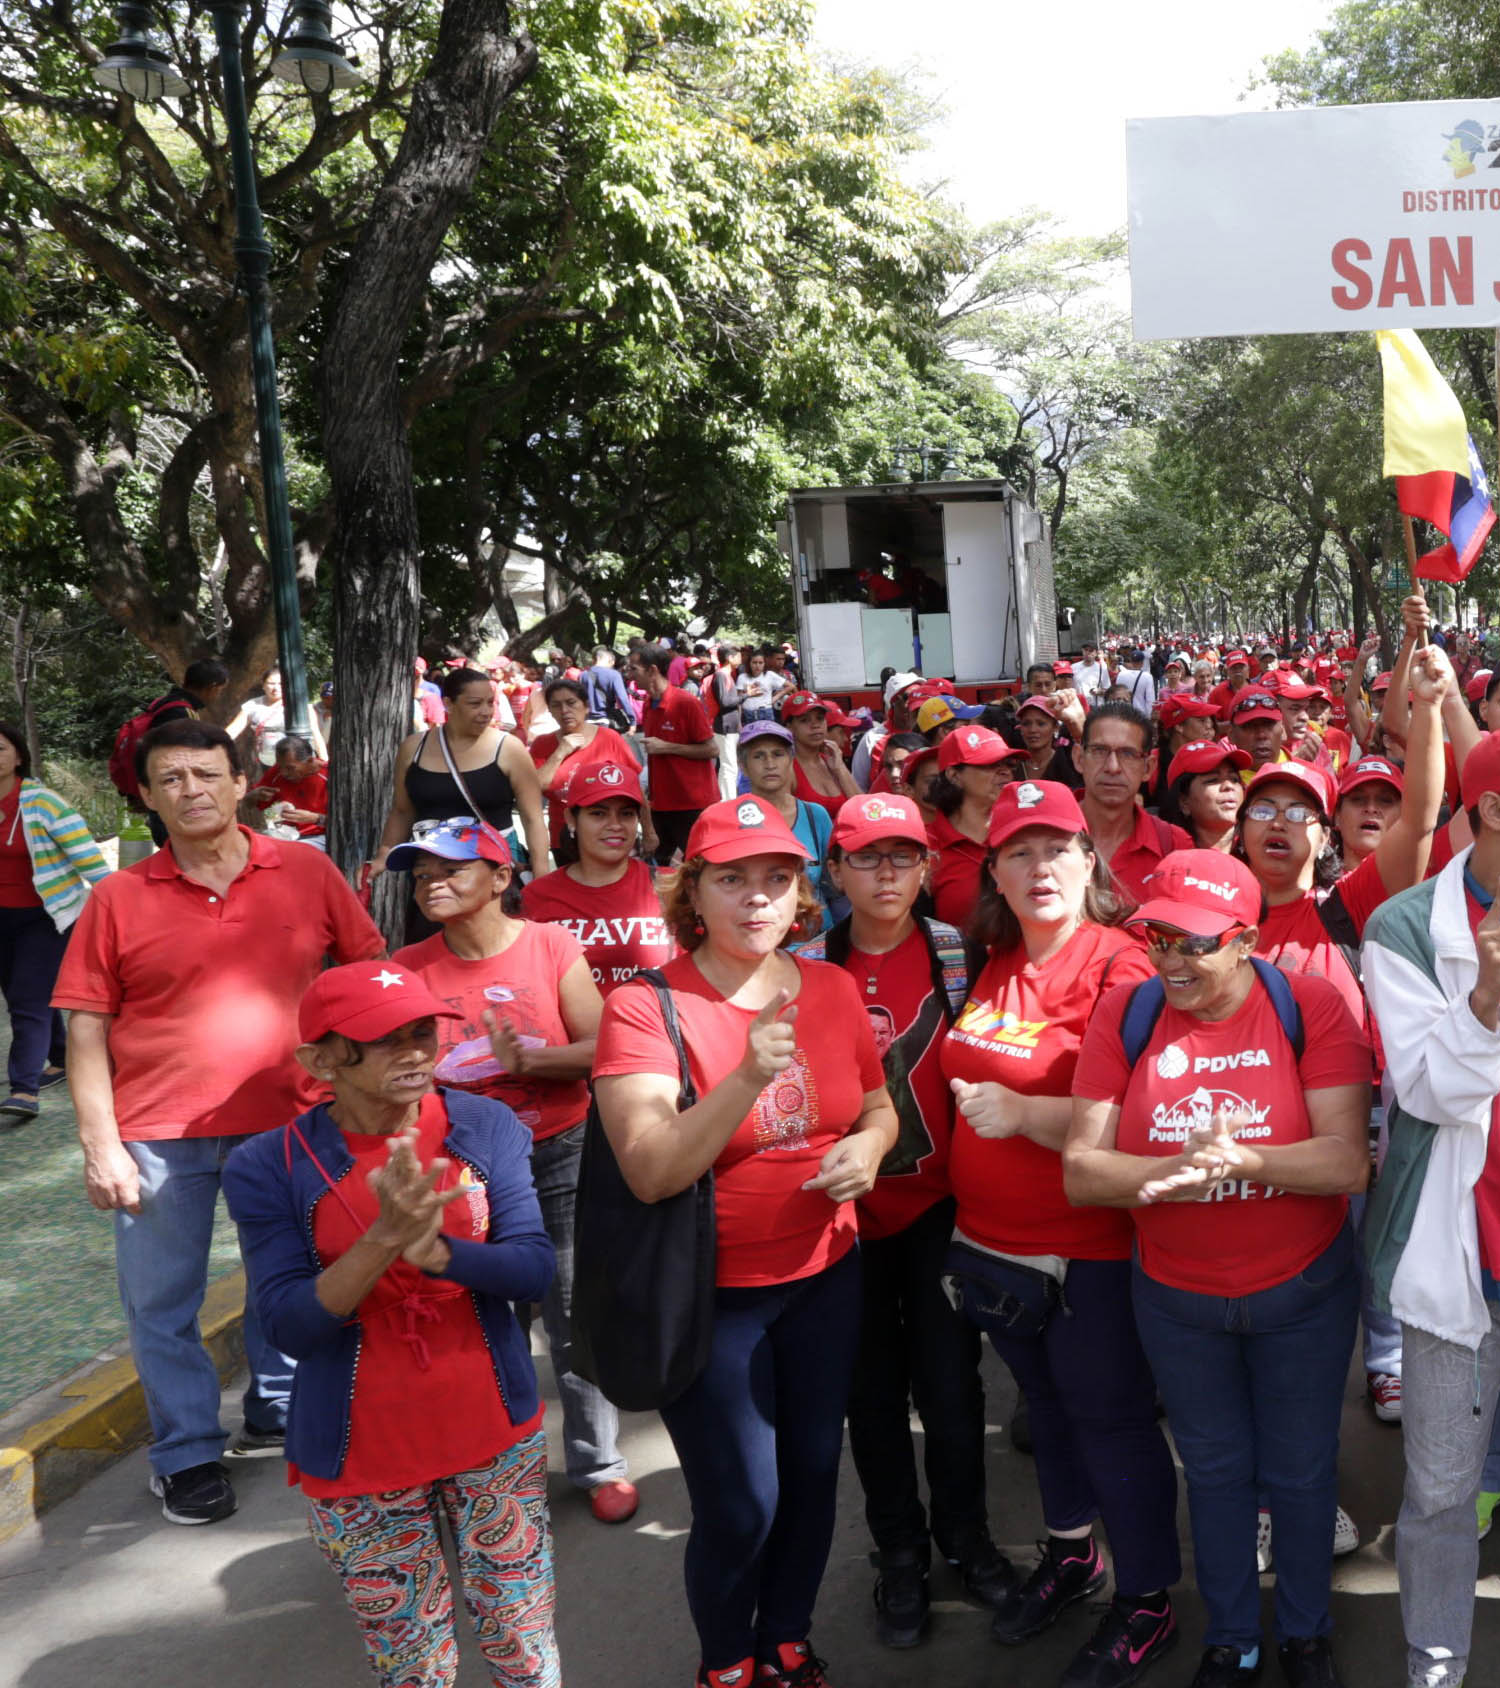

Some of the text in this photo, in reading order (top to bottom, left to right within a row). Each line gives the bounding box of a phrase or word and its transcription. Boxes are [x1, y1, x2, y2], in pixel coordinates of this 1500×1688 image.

[1331, 236, 1475, 311] SAN
[555, 917, 670, 946] HAVEZ
[987, 1041, 1033, 1060] PATRIA
[1193, 1049, 1271, 1074] PDVSA
[1149, 1127, 1190, 1143] Puebl
